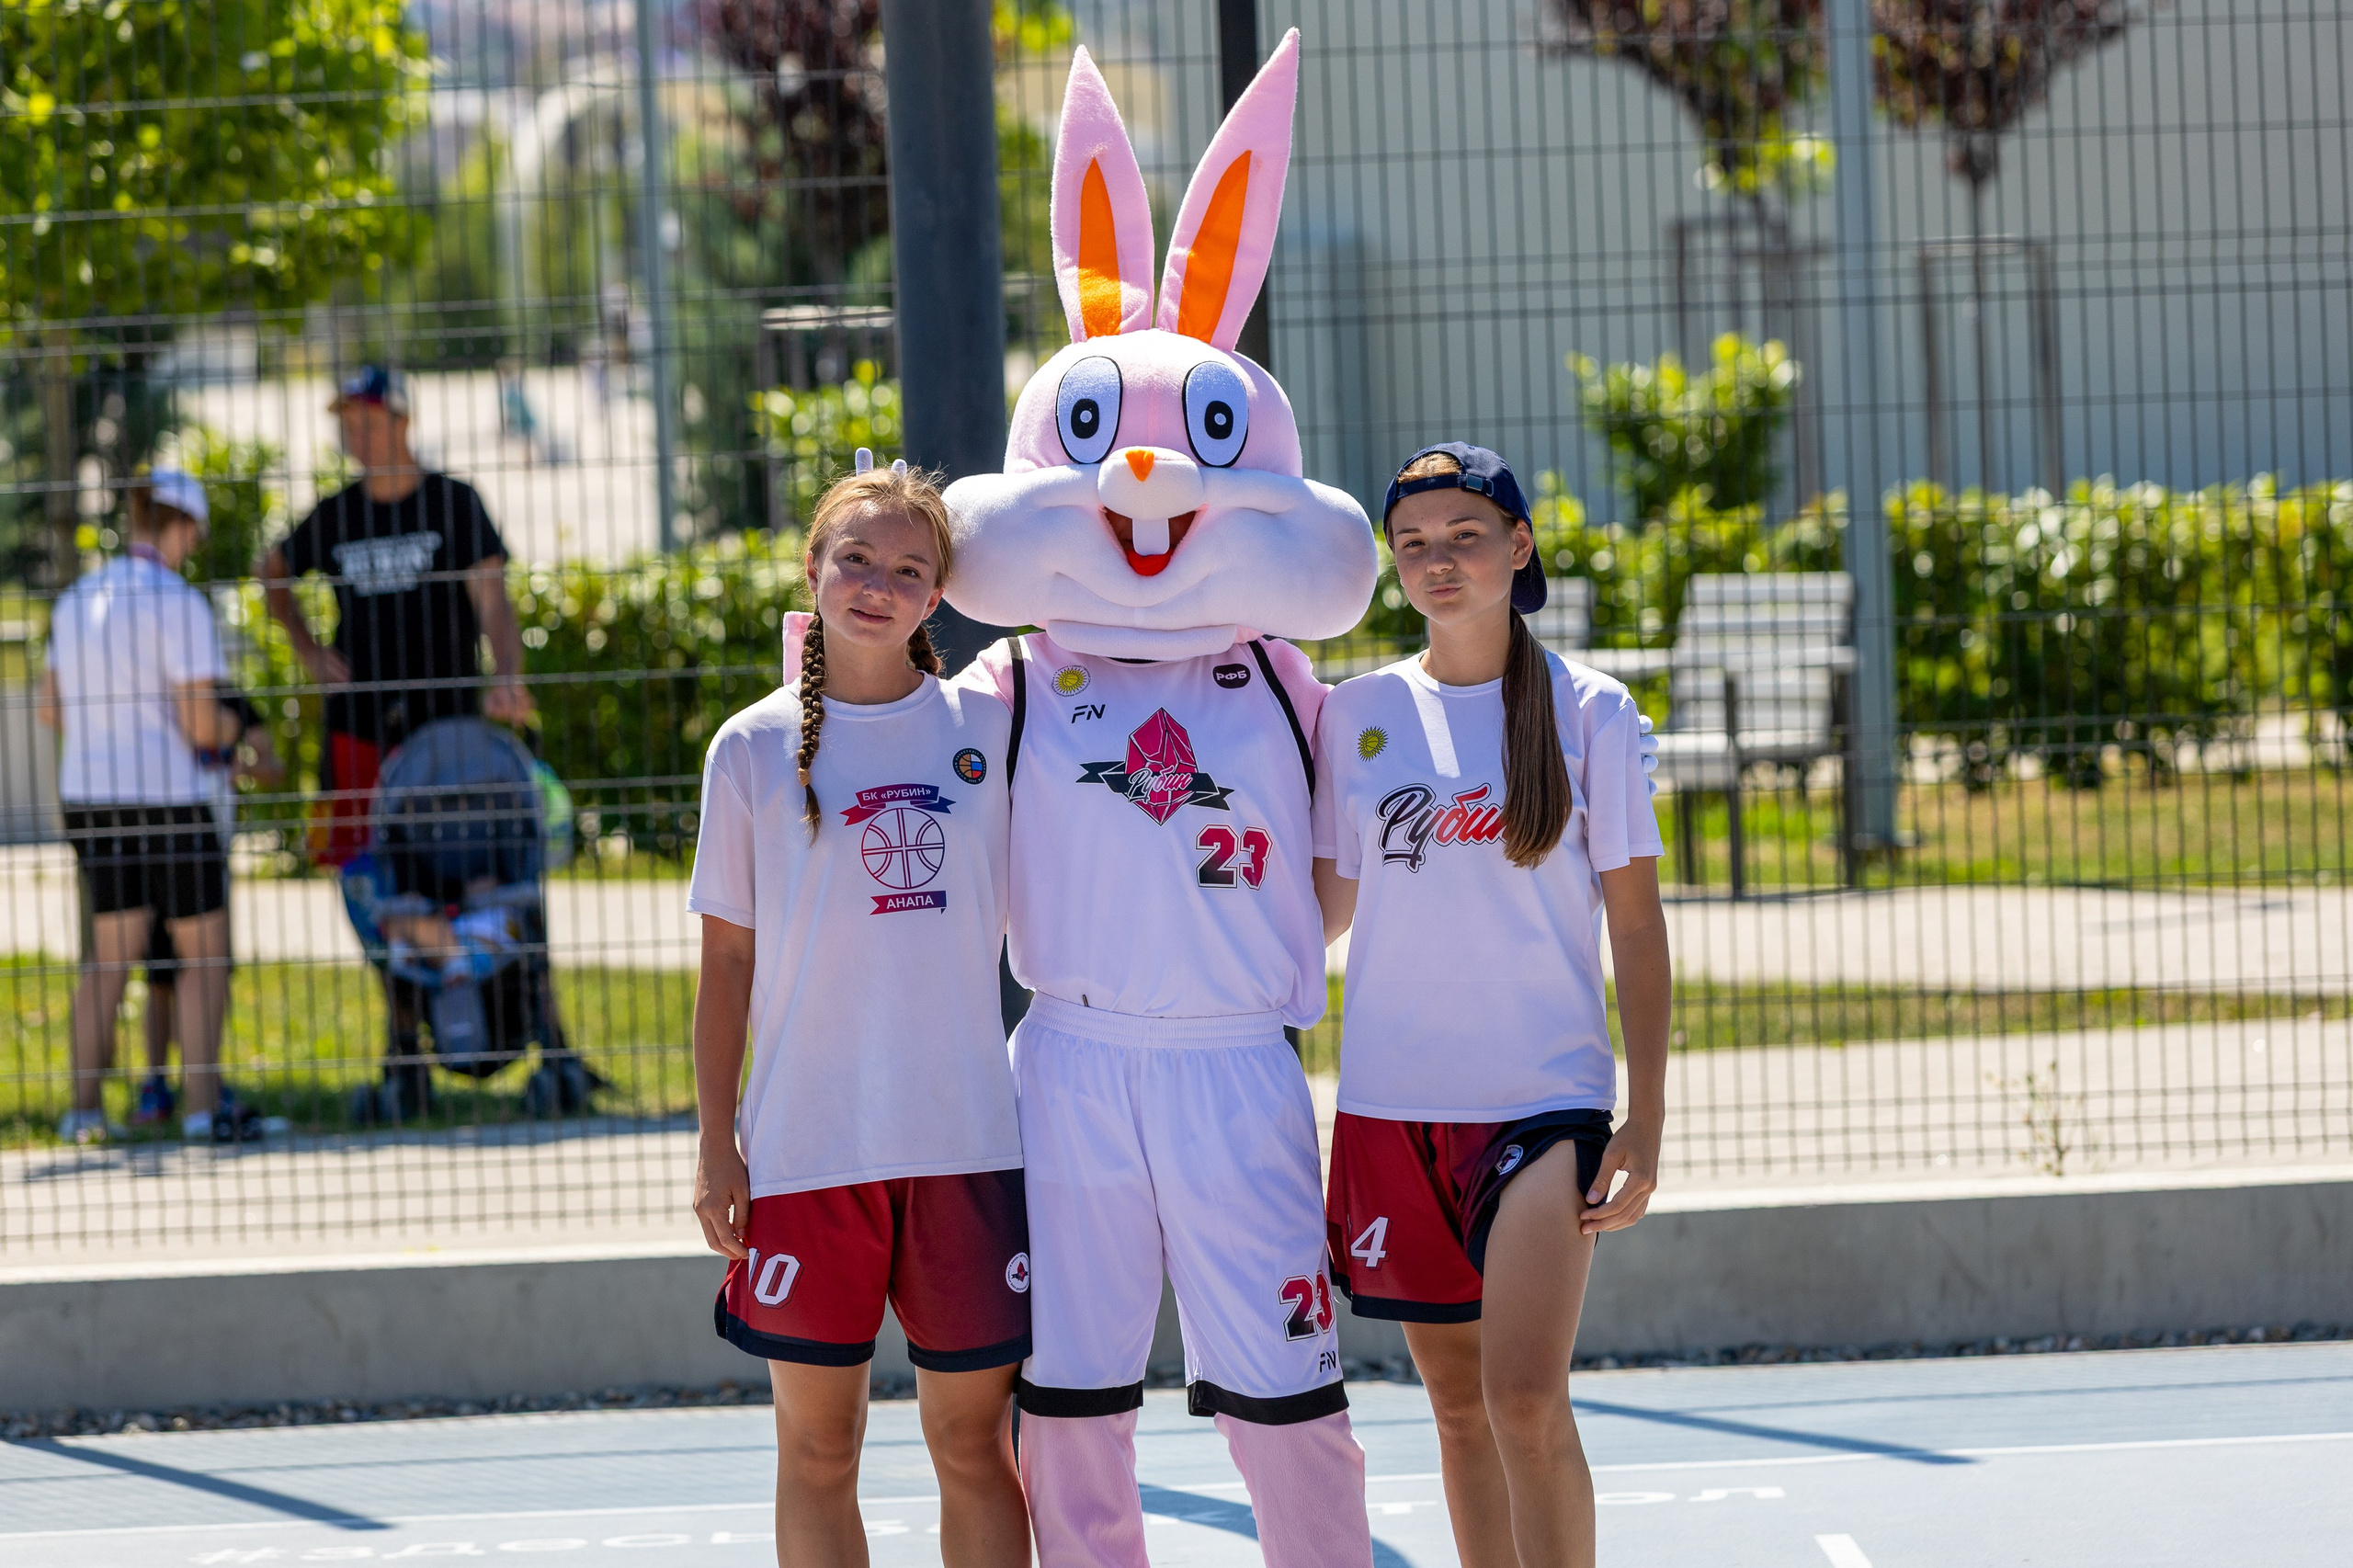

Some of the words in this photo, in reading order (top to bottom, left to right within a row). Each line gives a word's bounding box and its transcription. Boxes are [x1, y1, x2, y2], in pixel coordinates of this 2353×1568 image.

[1216, 670, 1247, 682] РФБ
[862, 790, 878, 801] БК
[881, 787, 932, 800] «РУБИН»
[1127, 765, 1193, 804] Рубин
[1376, 782, 1508, 873] Руби
[1196, 824, 1274, 891] 23
[886, 894, 935, 909] АНАПА
[1278, 1270, 1336, 1342] 23
